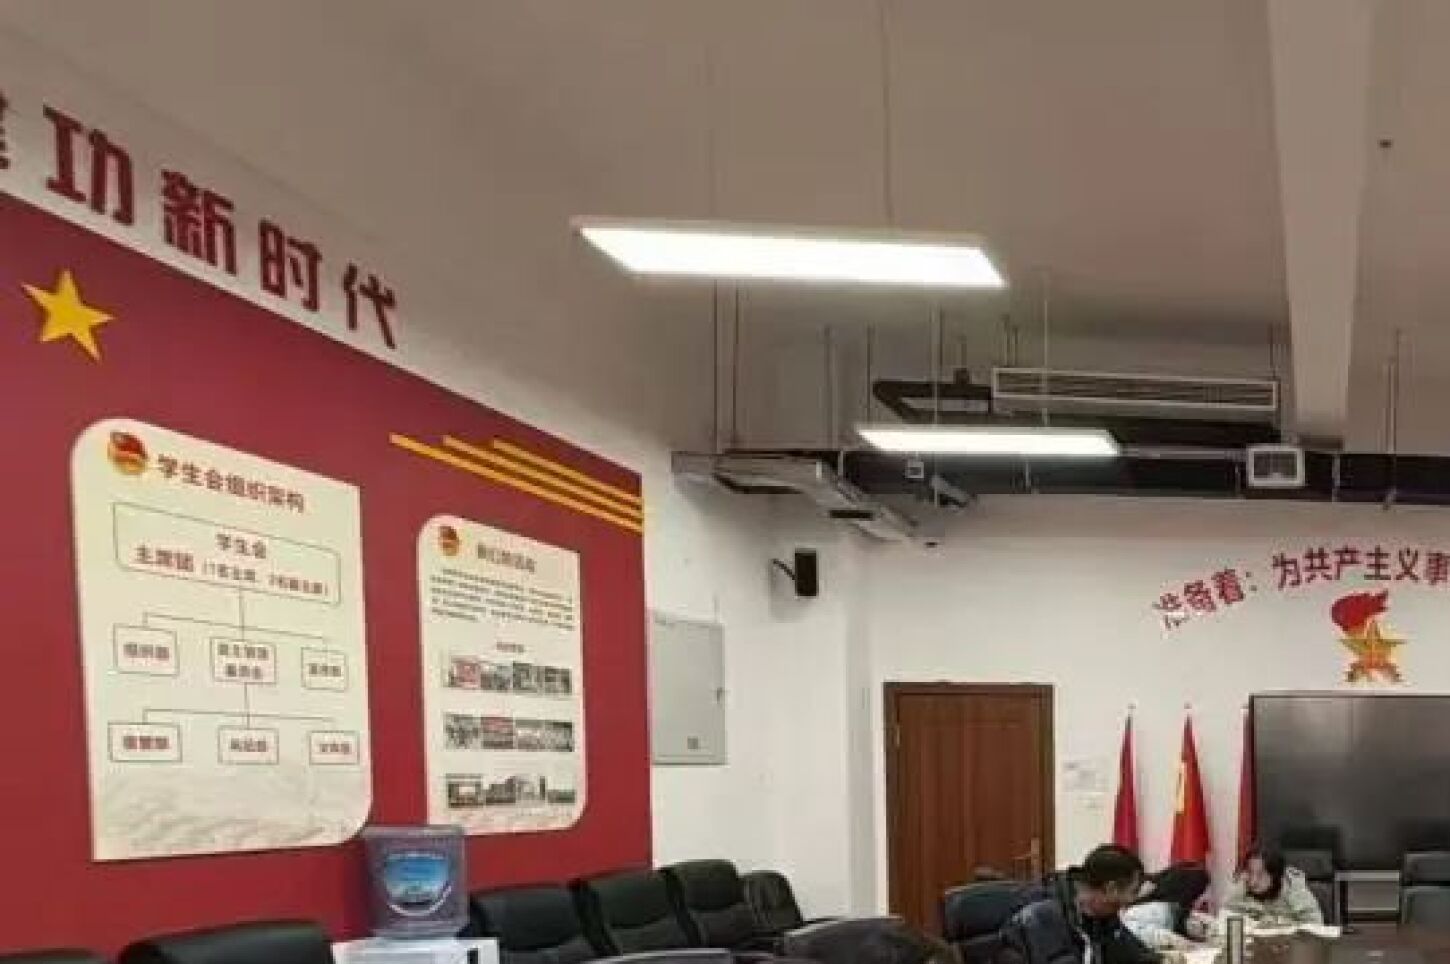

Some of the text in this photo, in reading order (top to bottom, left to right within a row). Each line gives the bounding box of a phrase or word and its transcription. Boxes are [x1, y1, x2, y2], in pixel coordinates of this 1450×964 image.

[0, 90, 396, 349] 功新时代
[158, 453, 305, 513] 学生会组织架构
